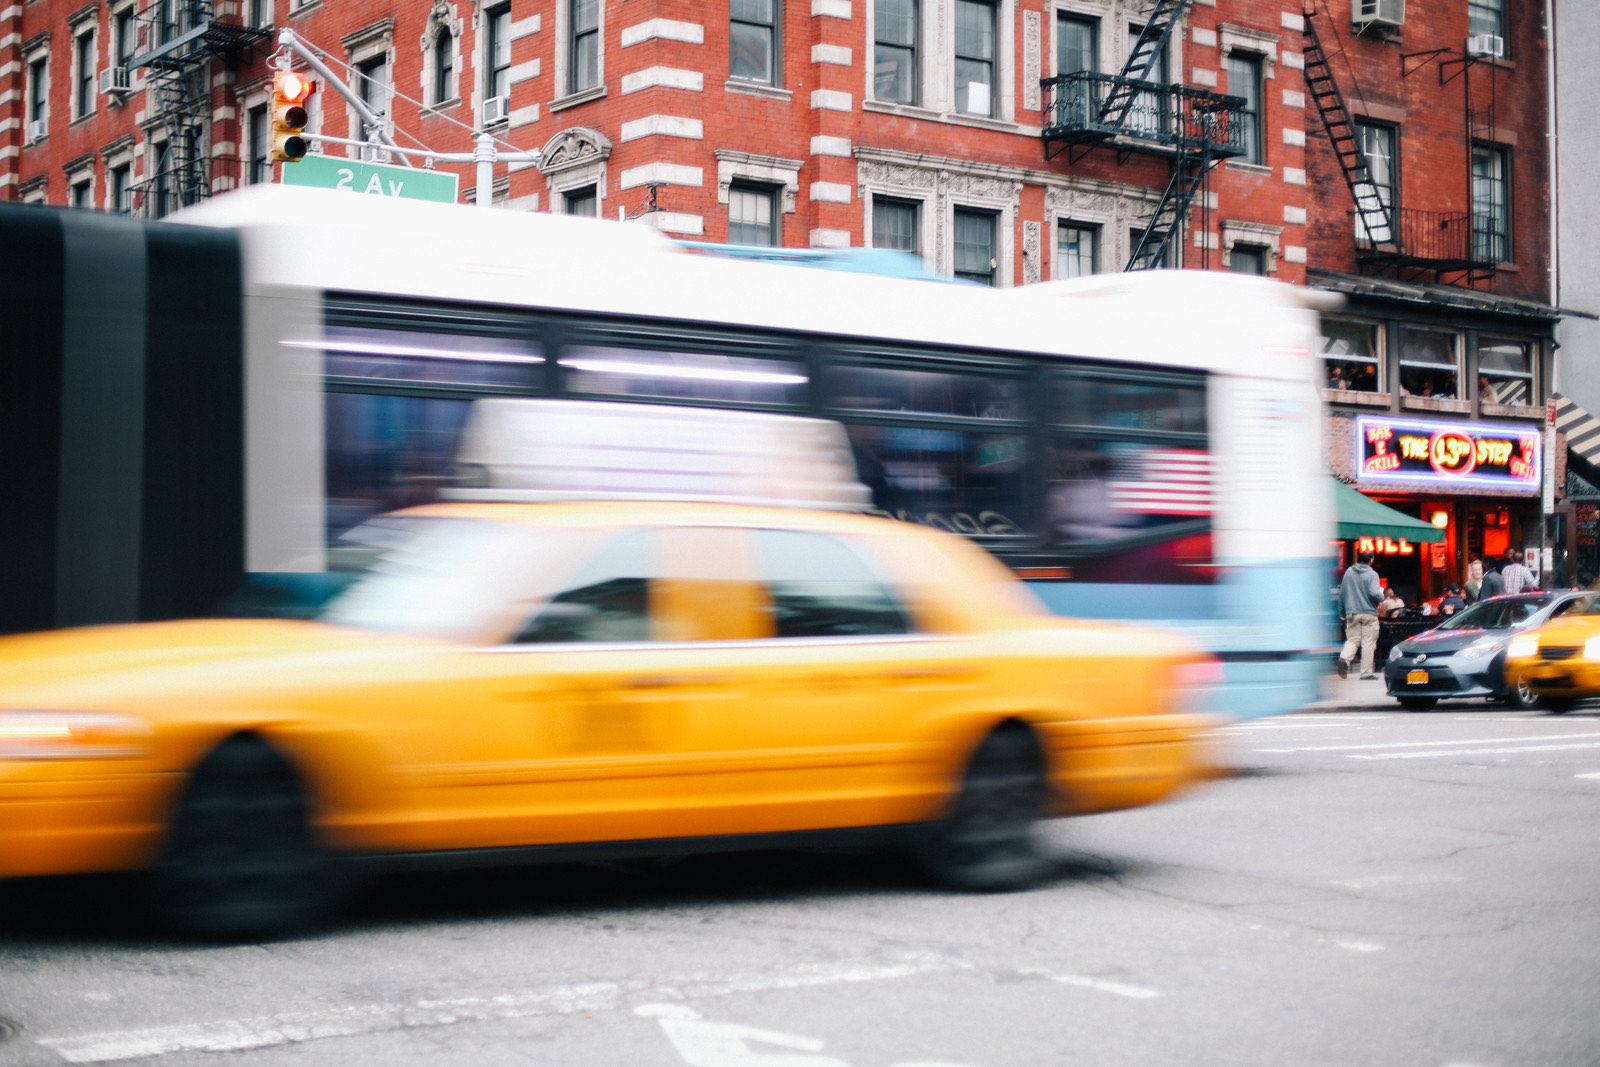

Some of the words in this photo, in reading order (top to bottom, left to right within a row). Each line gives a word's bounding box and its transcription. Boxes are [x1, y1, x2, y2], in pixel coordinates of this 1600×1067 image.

[335, 168, 354, 191] 2
[364, 172, 404, 197] Av
[1366, 427, 1392, 442] BAR
[1400, 436, 1429, 459] THE
[1476, 440, 1513, 465] STEP
[1366, 454, 1400, 473] GRILL
